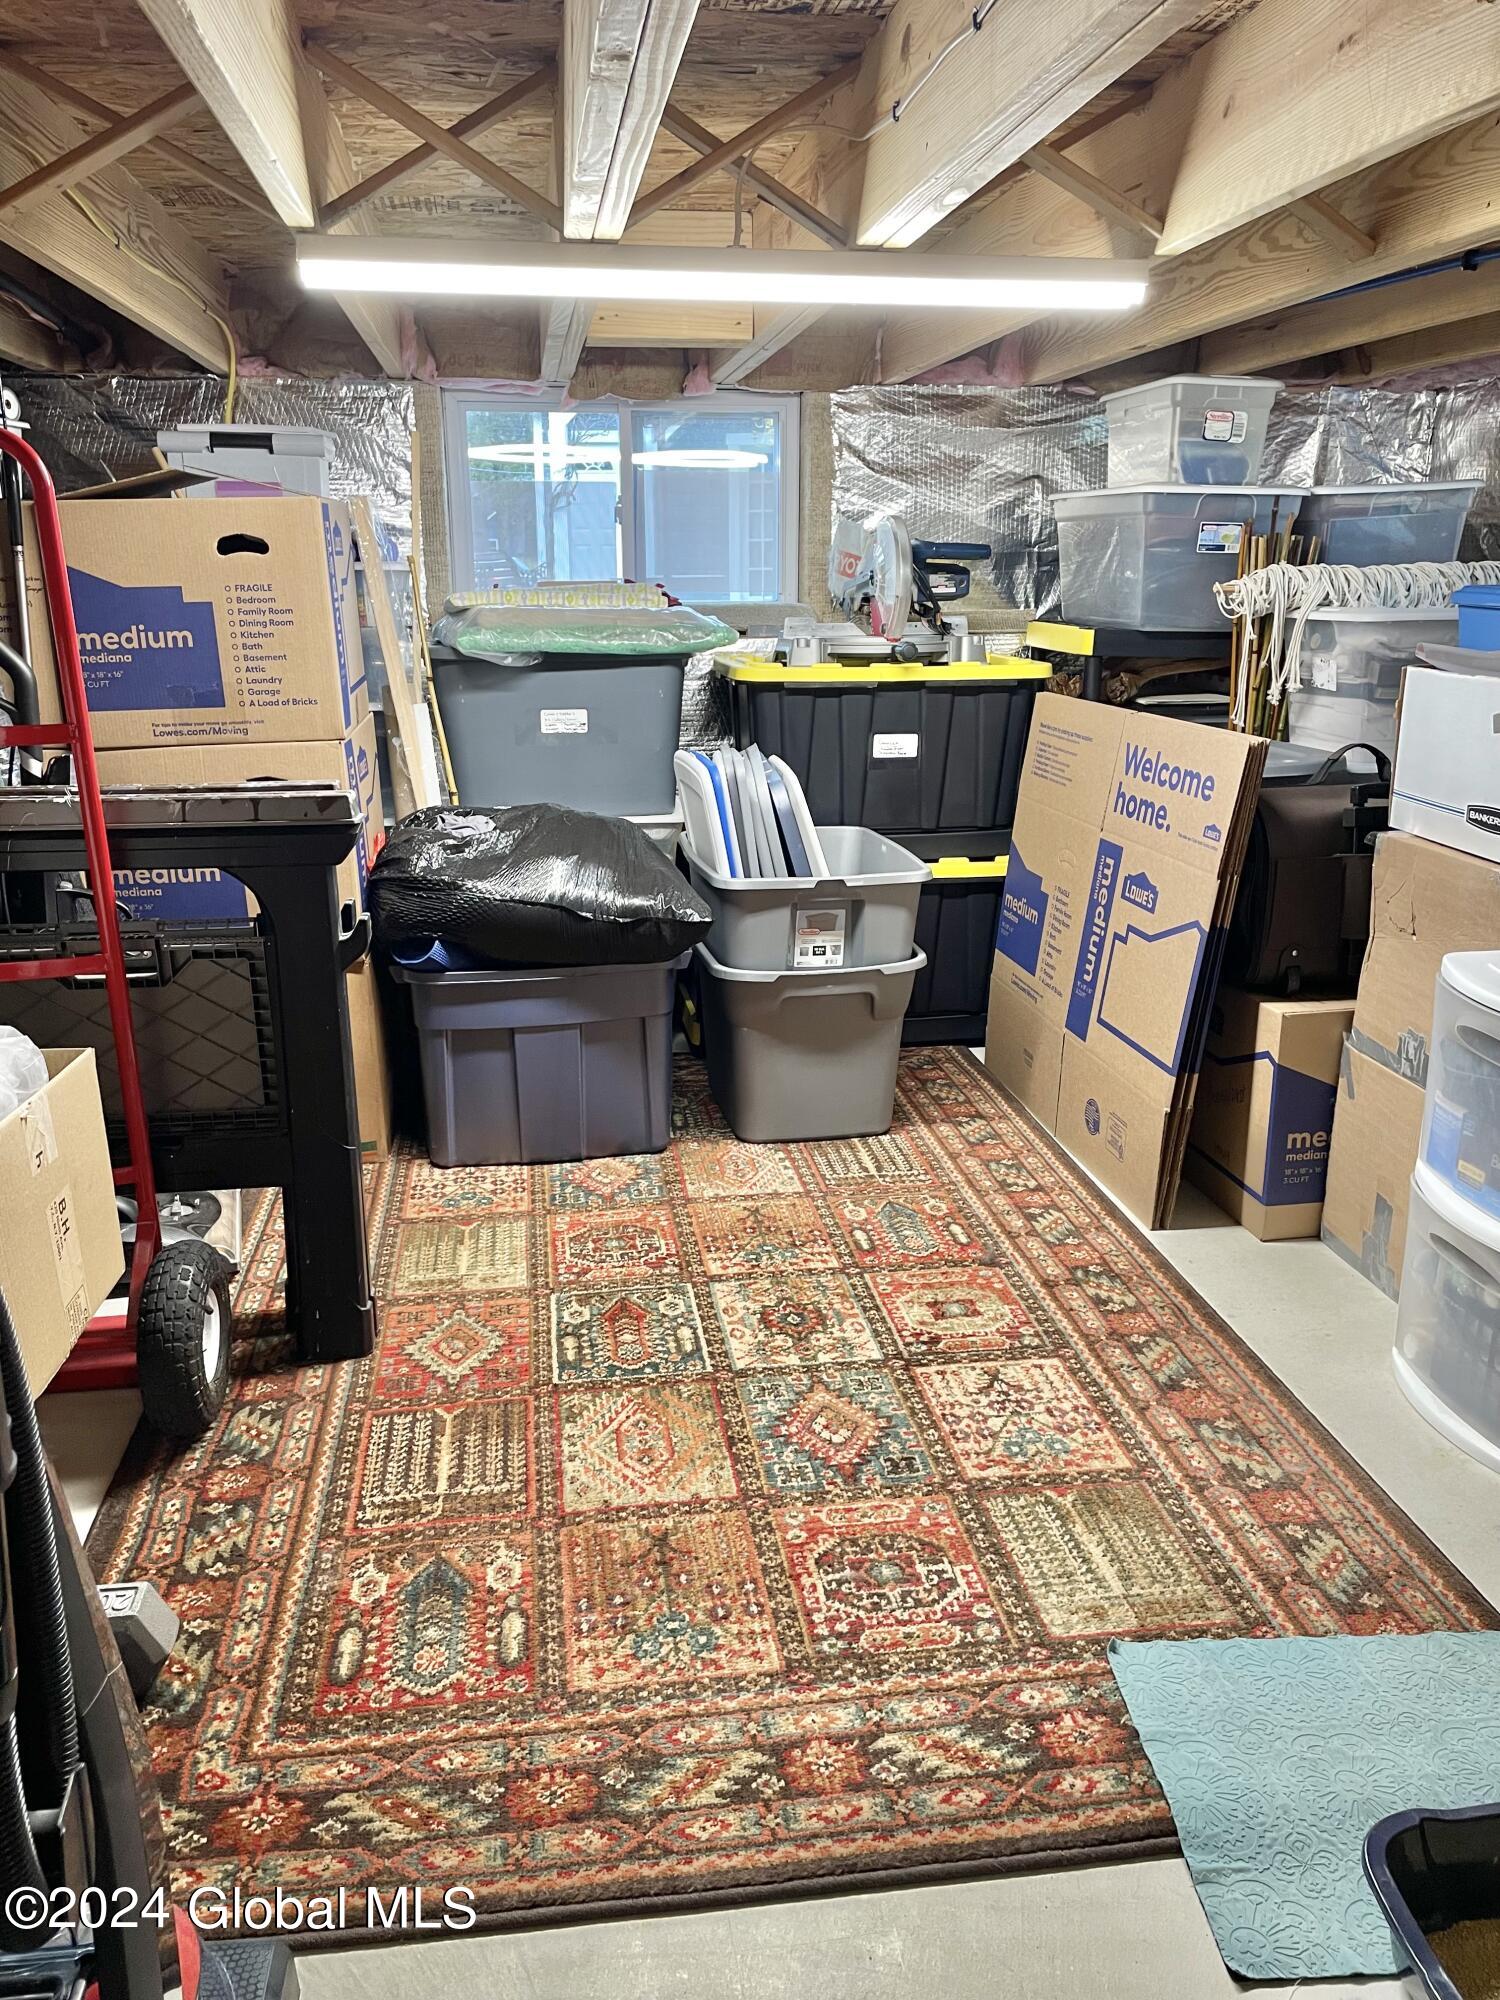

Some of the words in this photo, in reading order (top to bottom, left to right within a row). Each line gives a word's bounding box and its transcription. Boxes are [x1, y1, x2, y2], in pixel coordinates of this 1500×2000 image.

[234, 584, 272, 592] FRAGILE
[236, 596, 276, 604] Bedroom
[238, 608, 268, 616] Family
[238, 620, 268, 628] Dining
[76, 624, 194, 650] medium
[80, 652, 132, 664] mediana
[243, 654, 287, 662] Basement
[246, 677, 282, 685] Laundry
[248, 688, 281, 696] Garage
[258, 699, 281, 707] Load
[292, 698, 318, 706] Bricks
[153, 727, 248, 737] Lowes.com/Moving
[1124, 742, 1215, 801] Welcome
[1113, 781, 1170, 832] home.
[1470, 811, 1500, 826] BANKER
[1094, 856, 1104, 899] mediana
[114, 887, 162, 897] mediana
[1125, 880, 1154, 909] LOWE'S
[1004, 893, 1038, 925] medium
[1083, 857, 1114, 982] medium
[1287, 1130, 1328, 1149] me
[1286, 1150, 1327, 1161] median
